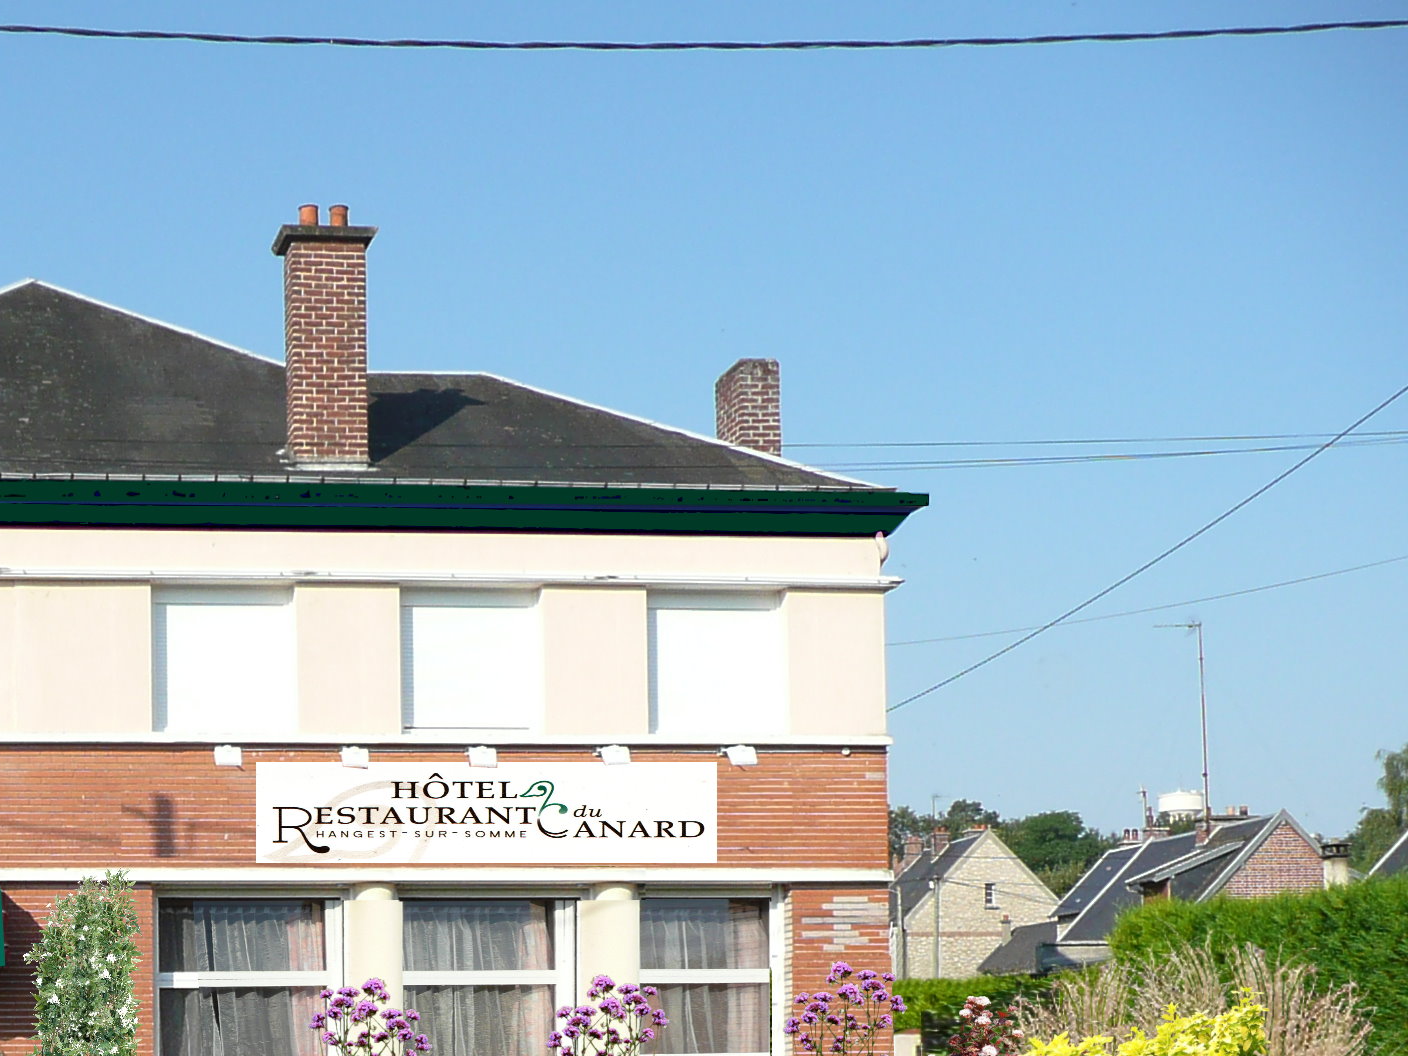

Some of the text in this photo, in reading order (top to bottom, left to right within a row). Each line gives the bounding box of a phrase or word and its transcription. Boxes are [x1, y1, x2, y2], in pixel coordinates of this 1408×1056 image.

[391, 773, 518, 799] HÔTEL
[537, 803, 705, 839] CANARD
[573, 804, 603, 818] du
[272, 806, 536, 853] RESTAURANT
